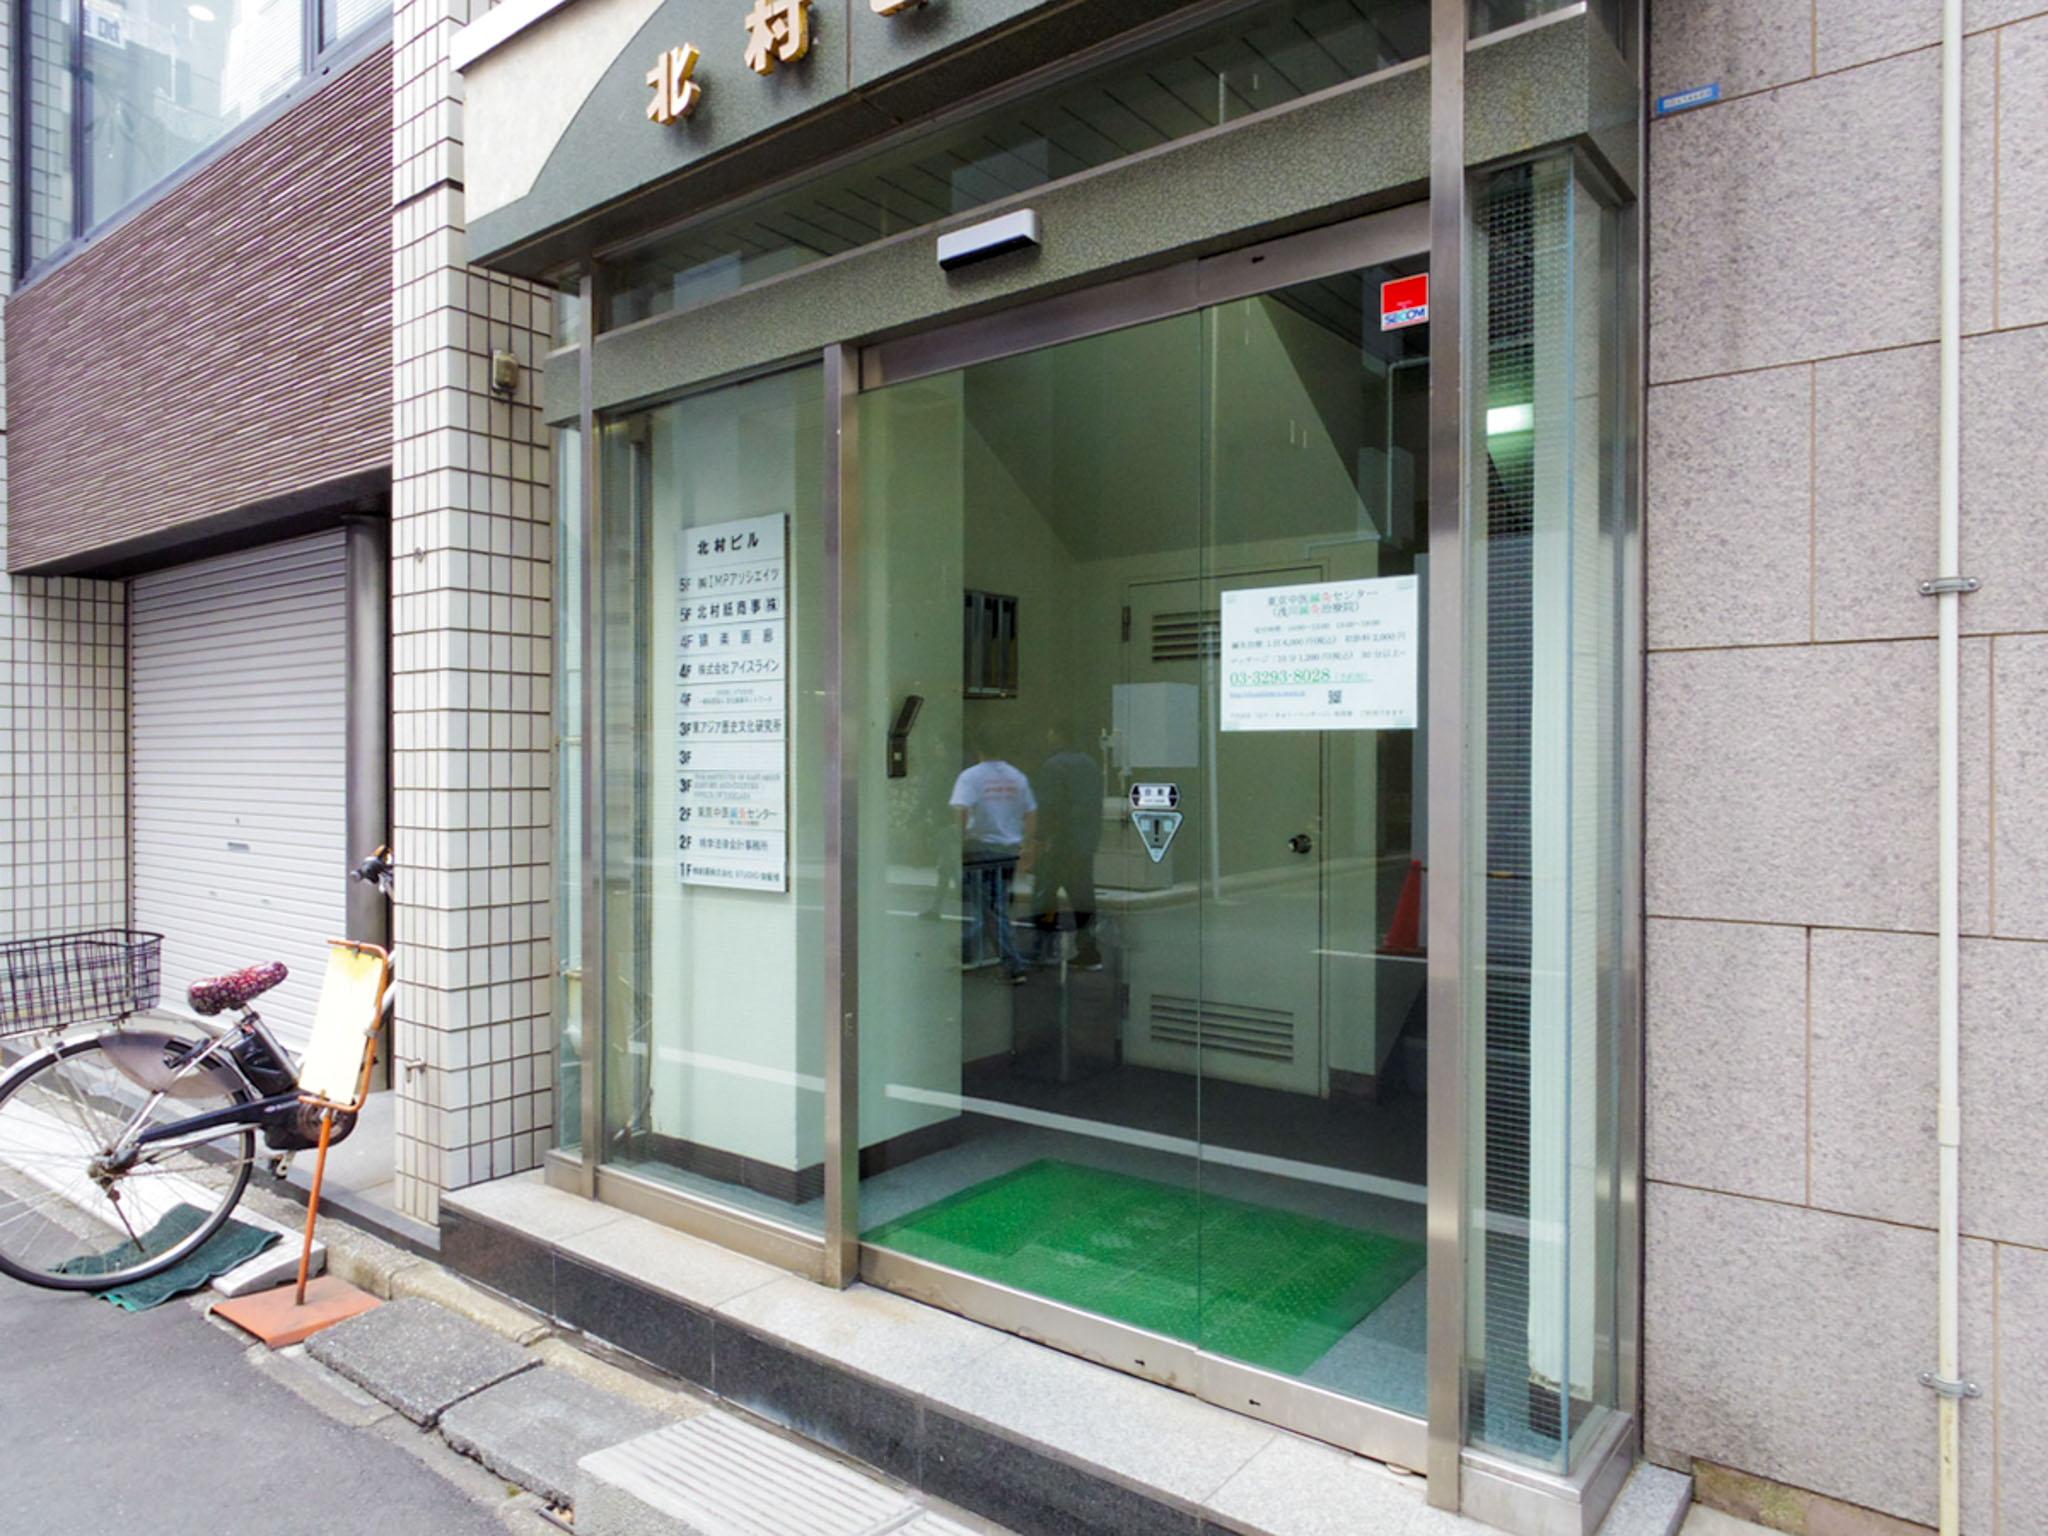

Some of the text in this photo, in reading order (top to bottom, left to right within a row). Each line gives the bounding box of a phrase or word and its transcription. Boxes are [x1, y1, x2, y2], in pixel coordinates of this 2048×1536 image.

[697, 531, 759, 556] 北村ビル
[679, 750, 692, 765] 3F
[679, 778, 692, 793] 3F
[679, 806, 692, 822] 2F
[679, 834, 692, 850] 2F
[680, 862, 692, 878] 1F
